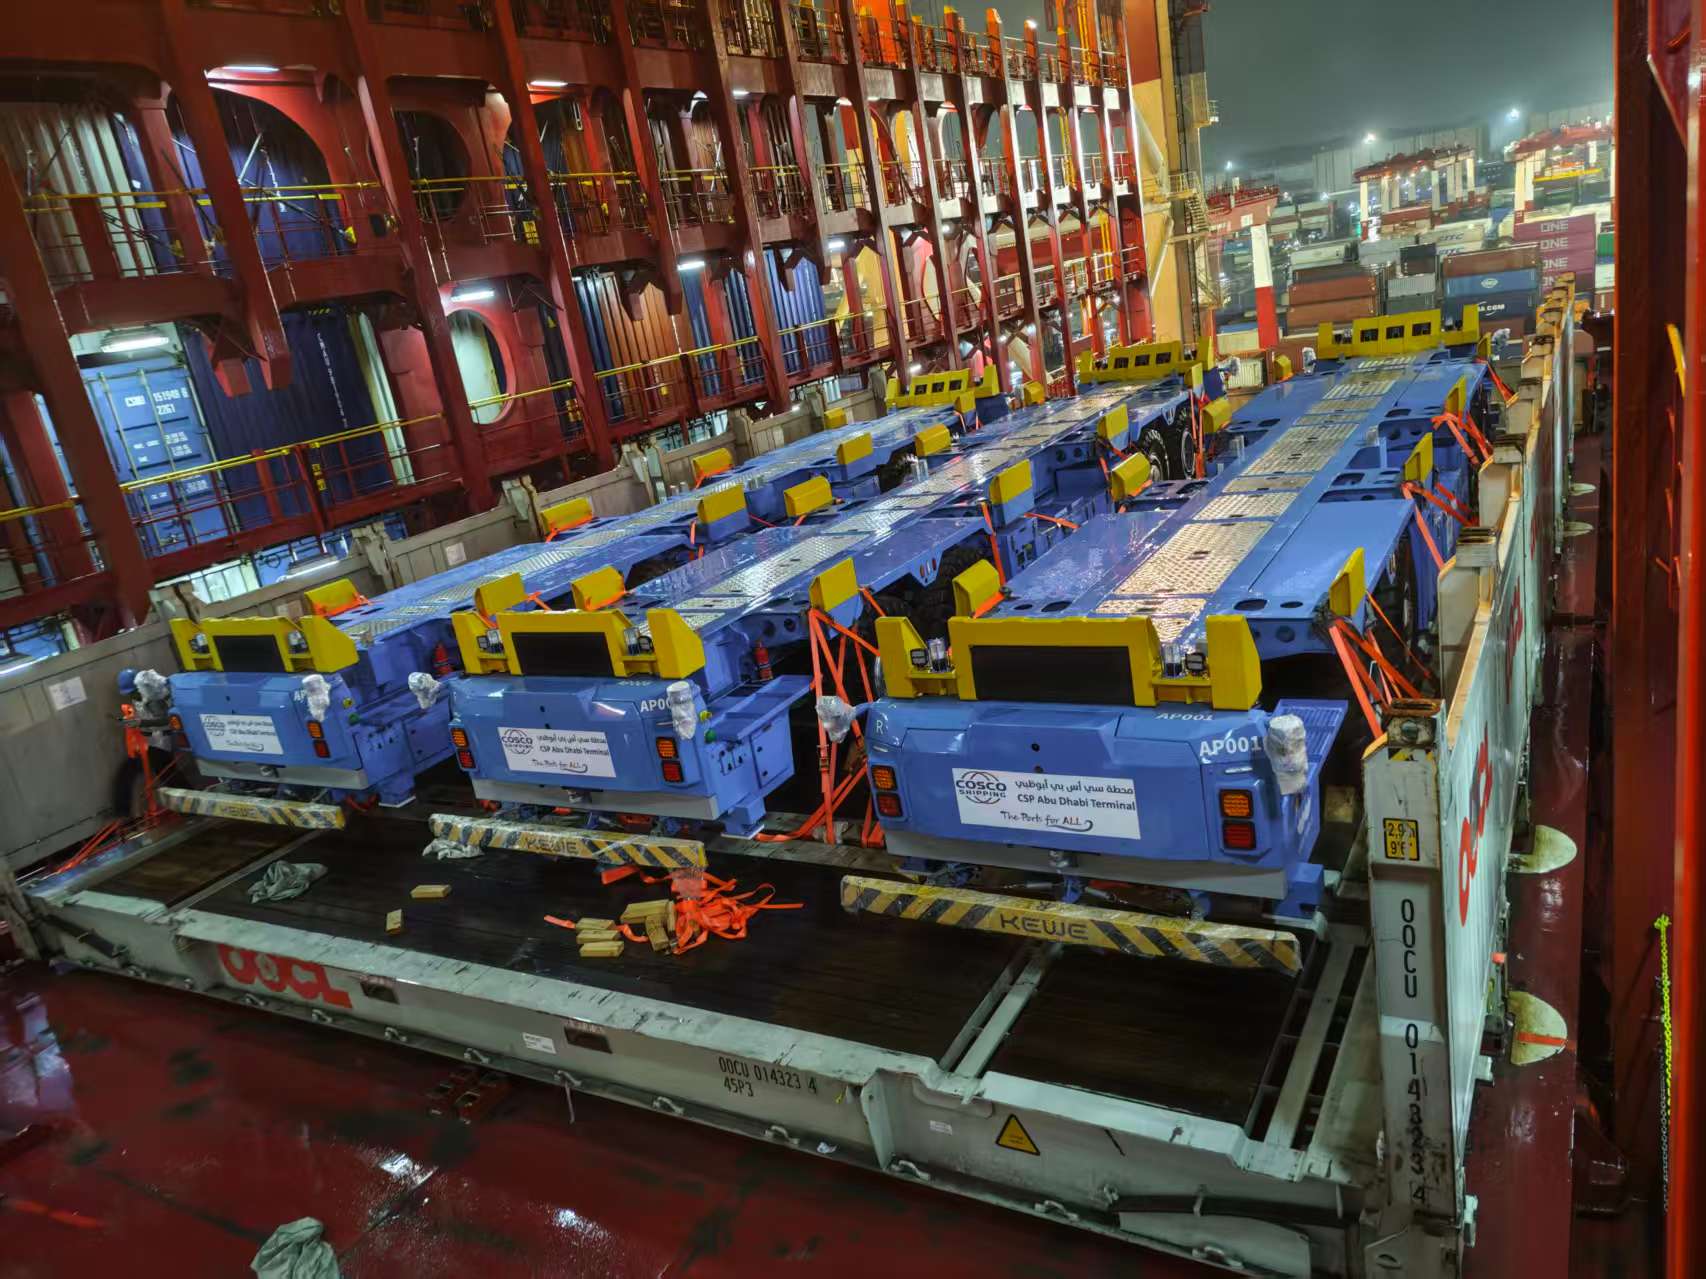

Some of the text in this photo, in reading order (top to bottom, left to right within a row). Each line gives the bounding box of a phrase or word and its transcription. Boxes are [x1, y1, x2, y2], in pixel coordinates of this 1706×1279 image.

[1155, 712, 1213, 721] AP001
[876, 719, 884, 735] R
[501, 736, 533, 744] COSCO
[1200, 736, 1262, 757] AP001
[956, 780, 1007, 792] COSCO
[959, 789, 1006, 798] SHIPPING
[1017, 793, 1136, 811] CSP Abu Dhabi Terminal
[1000, 811, 1082, 827] The Ports for ALL
[1000, 913, 1089, 940] KEWE
[1401, 899, 1417, 998] OOCU
[718, 1056, 817, 1094] OOCU 014323 4
[724, 1077, 754, 1097] 45P3
